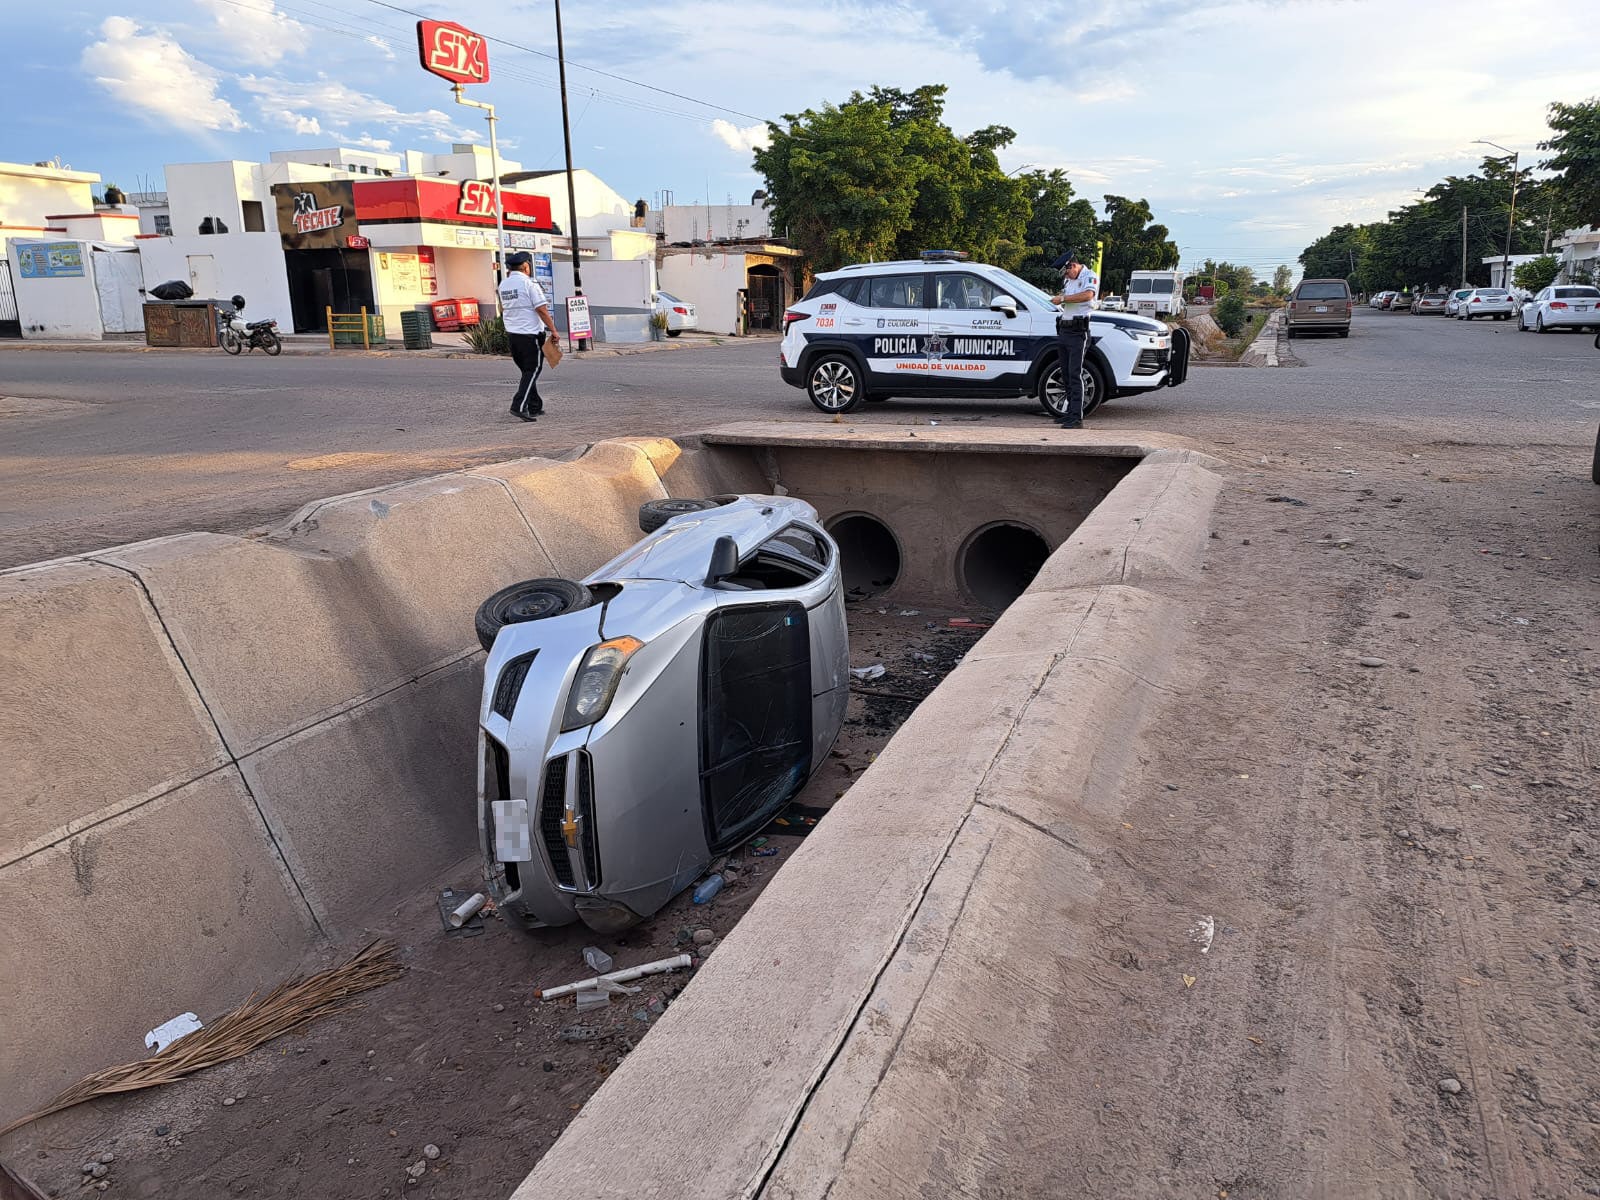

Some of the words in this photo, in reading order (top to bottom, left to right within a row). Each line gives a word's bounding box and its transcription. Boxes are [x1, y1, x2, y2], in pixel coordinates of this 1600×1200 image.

[296, 208, 338, 232] TECATE
[816, 318, 834, 328] 703A
[874, 334, 917, 354] POLICÍA
[953, 339, 1015, 355] MUNICIPAL
